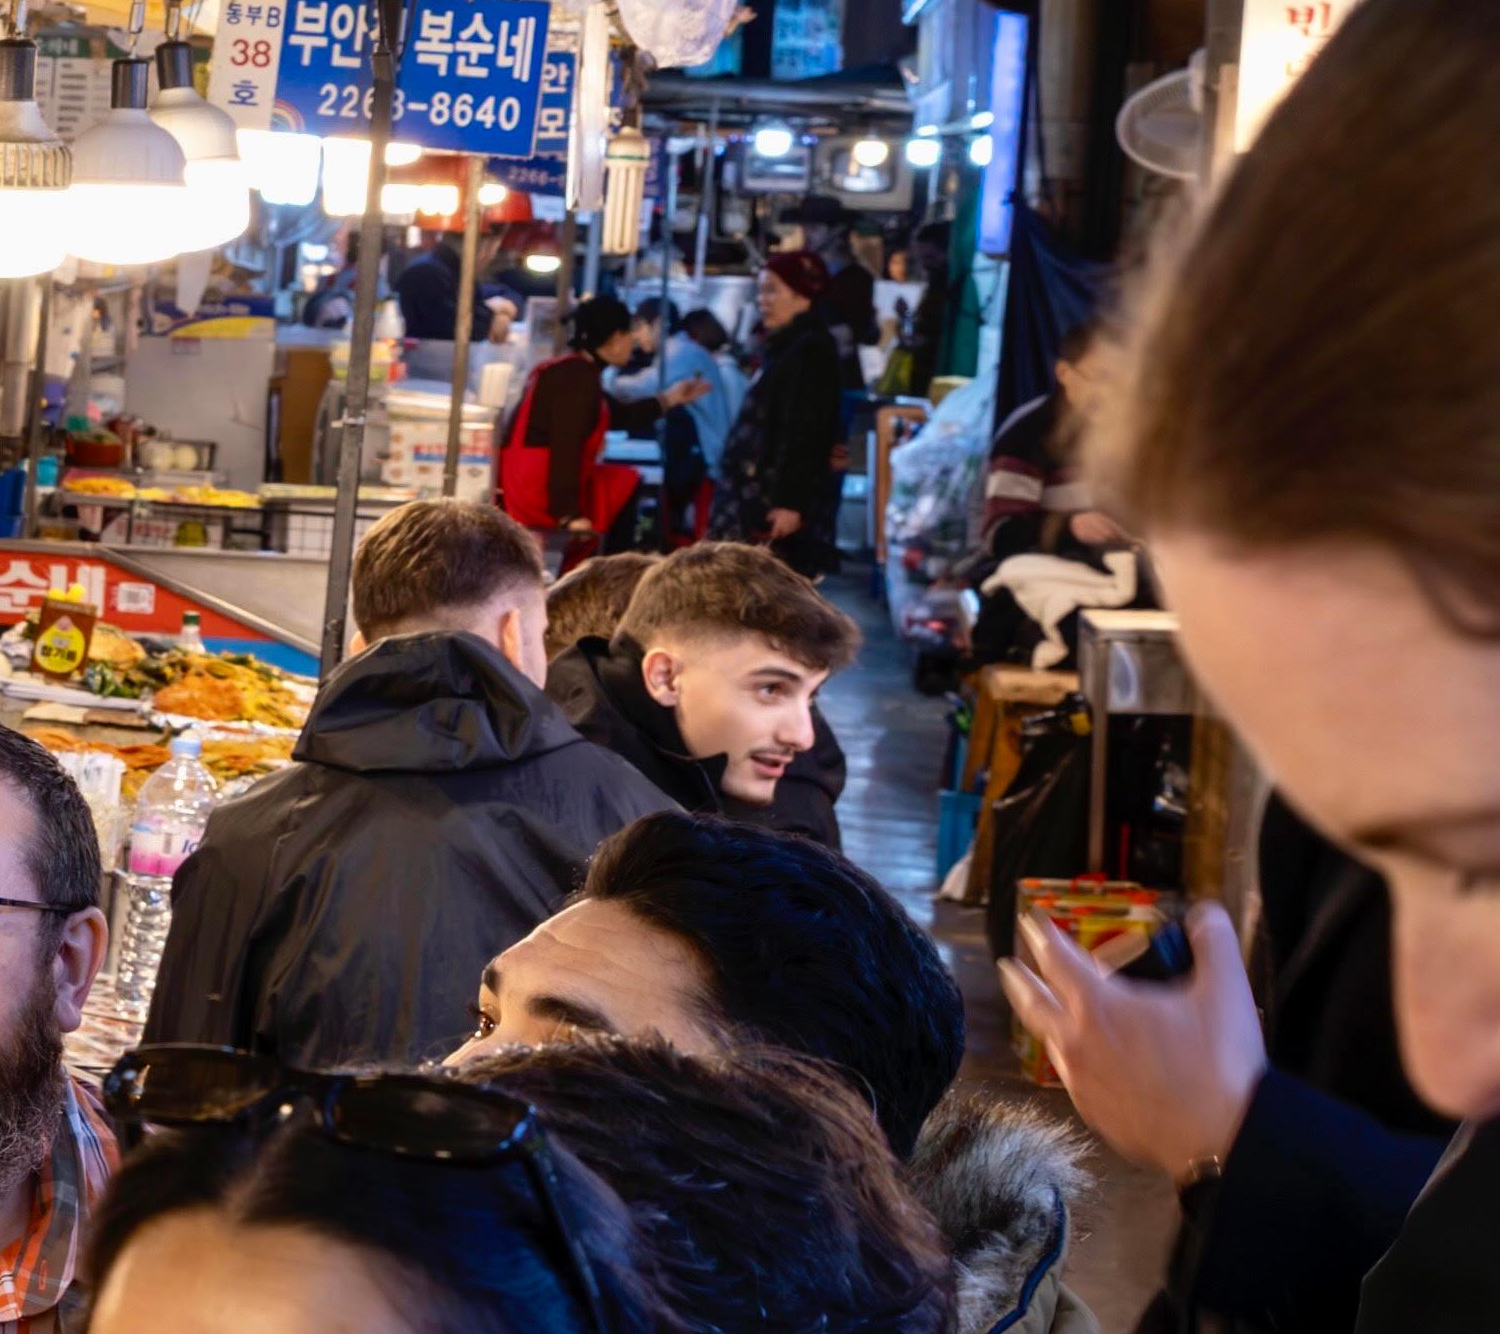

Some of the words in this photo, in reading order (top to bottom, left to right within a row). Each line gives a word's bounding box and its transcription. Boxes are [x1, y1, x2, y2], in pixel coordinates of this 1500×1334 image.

[227, 2, 282, 28] 동부B
[230, 38, 272, 68] 38
[414, 8, 537, 83] 복순네
[228, 79, 259, 107] 호
